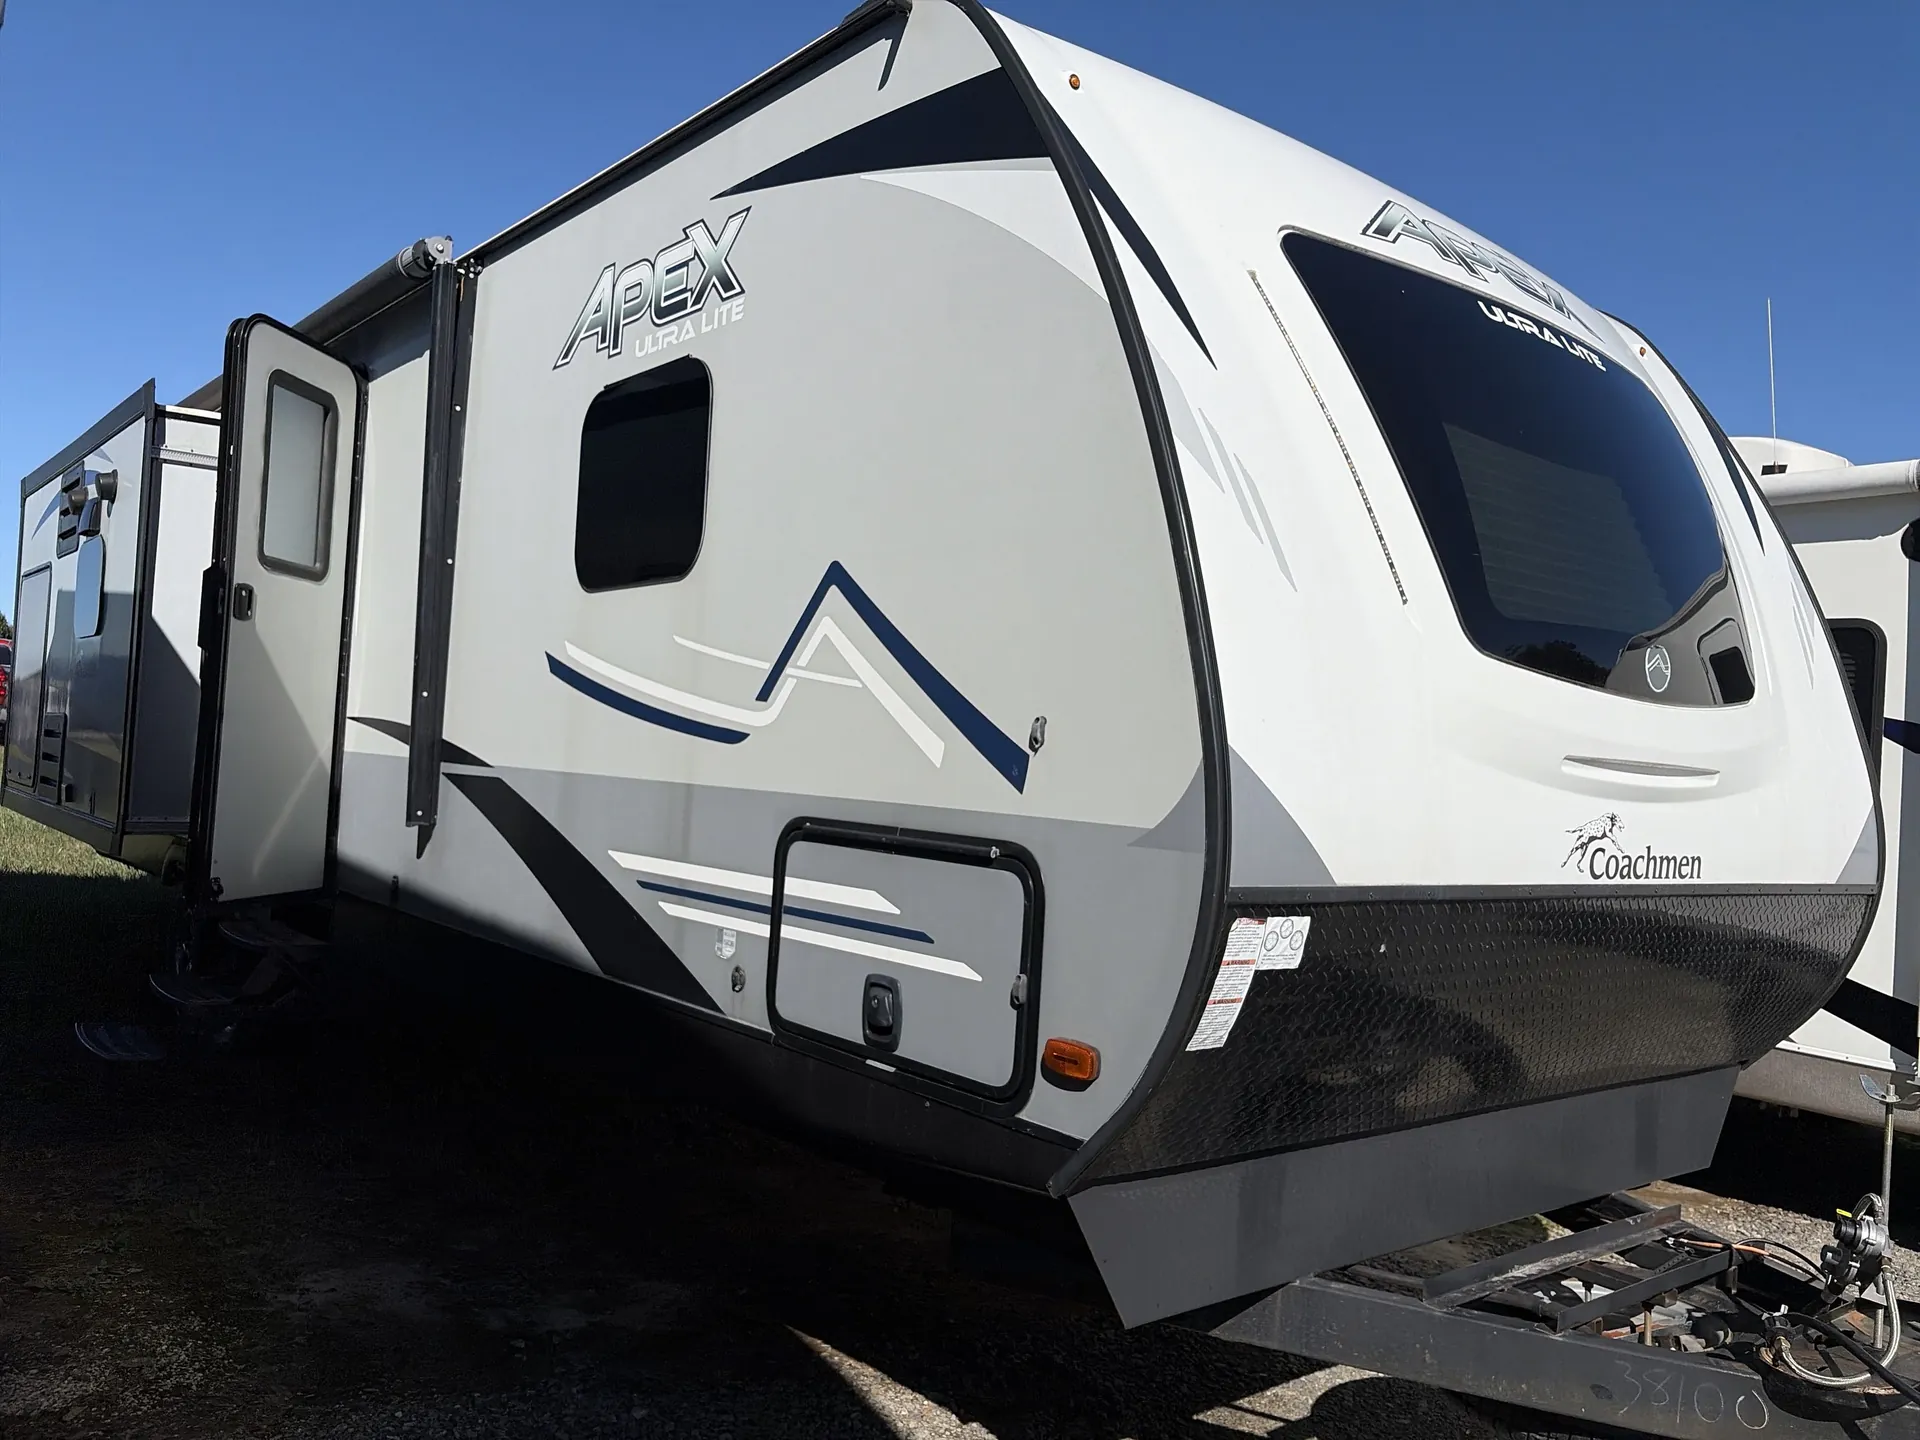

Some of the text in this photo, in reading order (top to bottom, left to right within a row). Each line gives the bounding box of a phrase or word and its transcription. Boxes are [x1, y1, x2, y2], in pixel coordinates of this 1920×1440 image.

[552, 205, 752, 371] APEX
[1360, 199, 1605, 344] APEX
[634, 297, 746, 358] ULTRA LITE
[1477, 300, 1607, 372] ULTRA LITE
[1589, 845, 1702, 880] Coachmen
[1614, 1359, 1769, 1430] 38100
